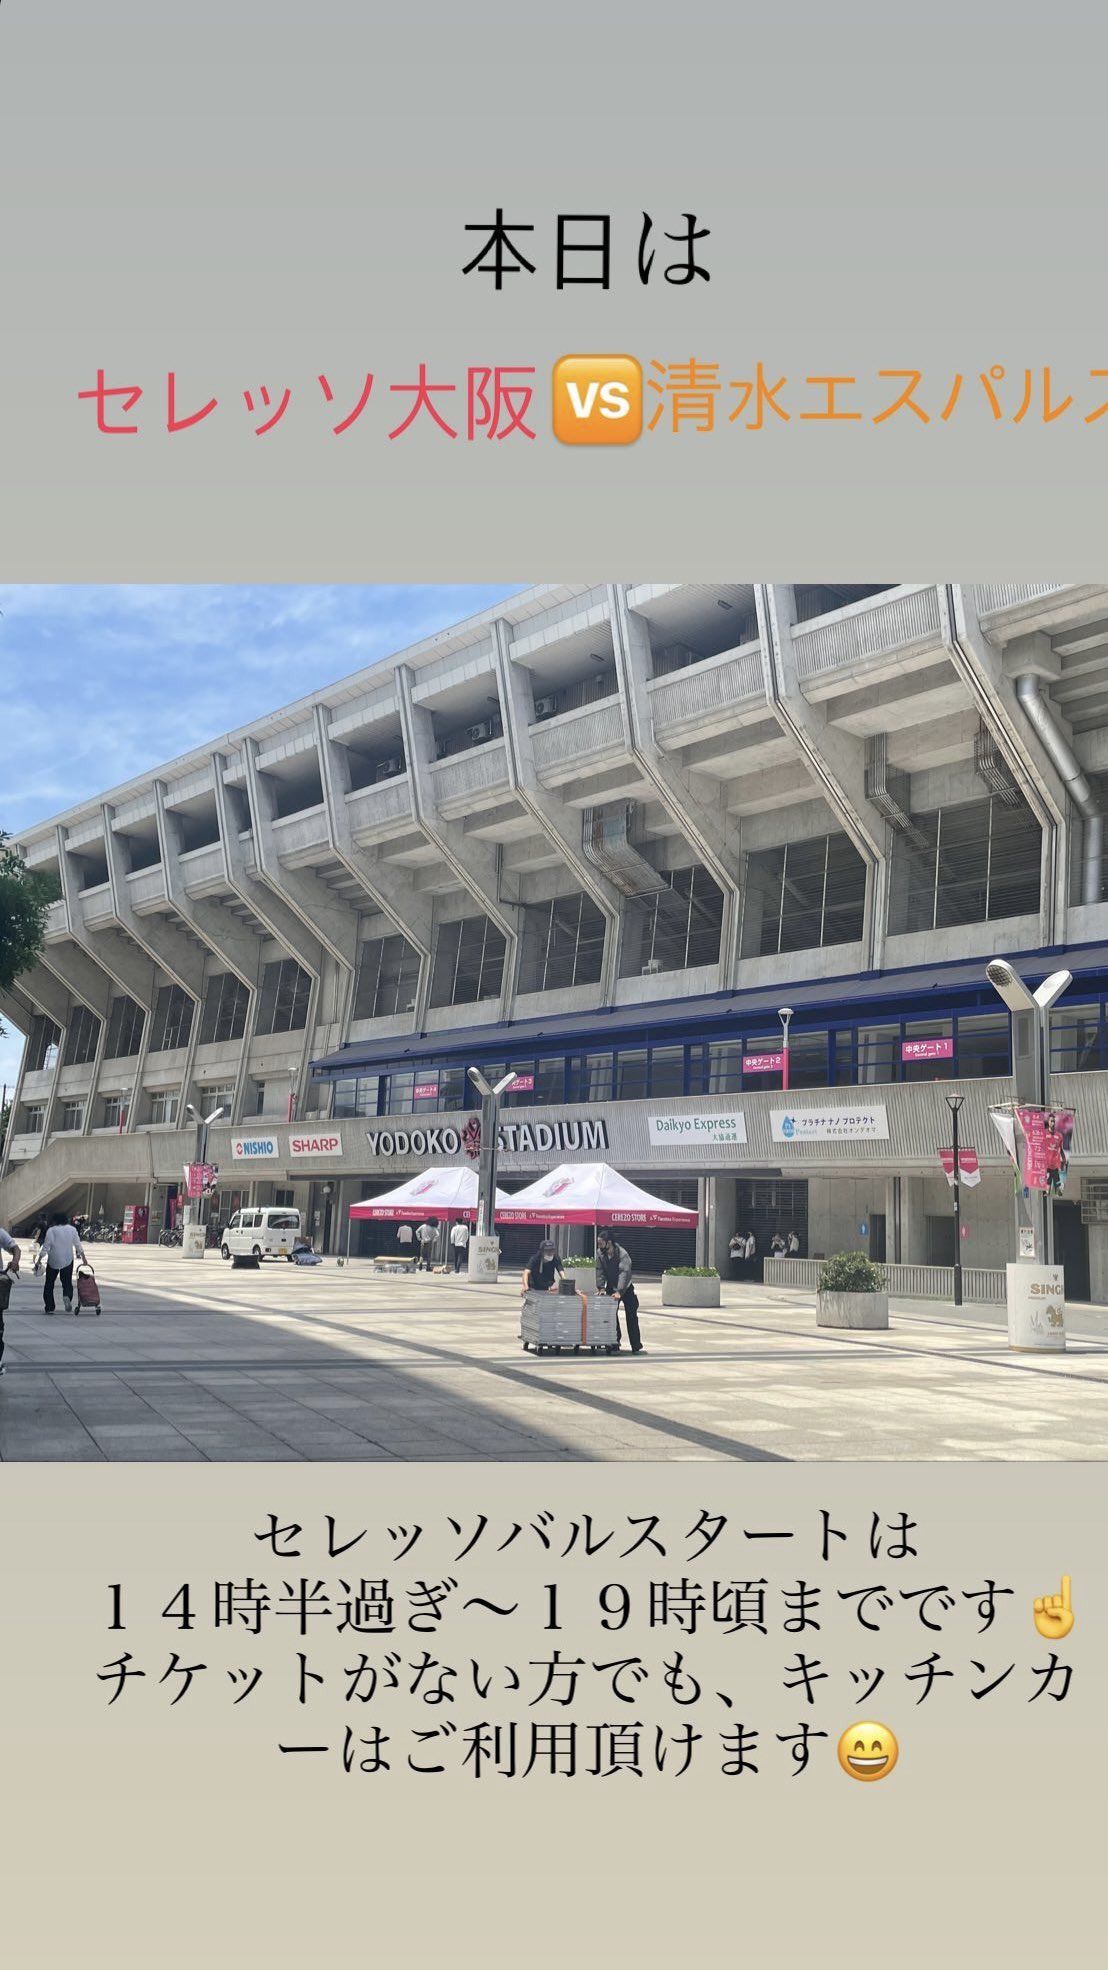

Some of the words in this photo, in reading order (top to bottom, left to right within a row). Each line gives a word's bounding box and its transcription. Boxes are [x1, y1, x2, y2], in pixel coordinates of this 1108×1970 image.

[656, 1118, 691, 1133] Daikyo
[694, 1118, 737, 1132] Express
[243, 1141, 274, 1155] NISHIO
[292, 1138, 339, 1152] SHARP
[366, 1128, 460, 1156] YODOKO
[500, 1211, 514, 1220] CEREZO
[515, 1211, 527, 1220] STORE
[611, 1213, 631, 1222] CEREZO
[631, 1213, 647, 1222] STORE
